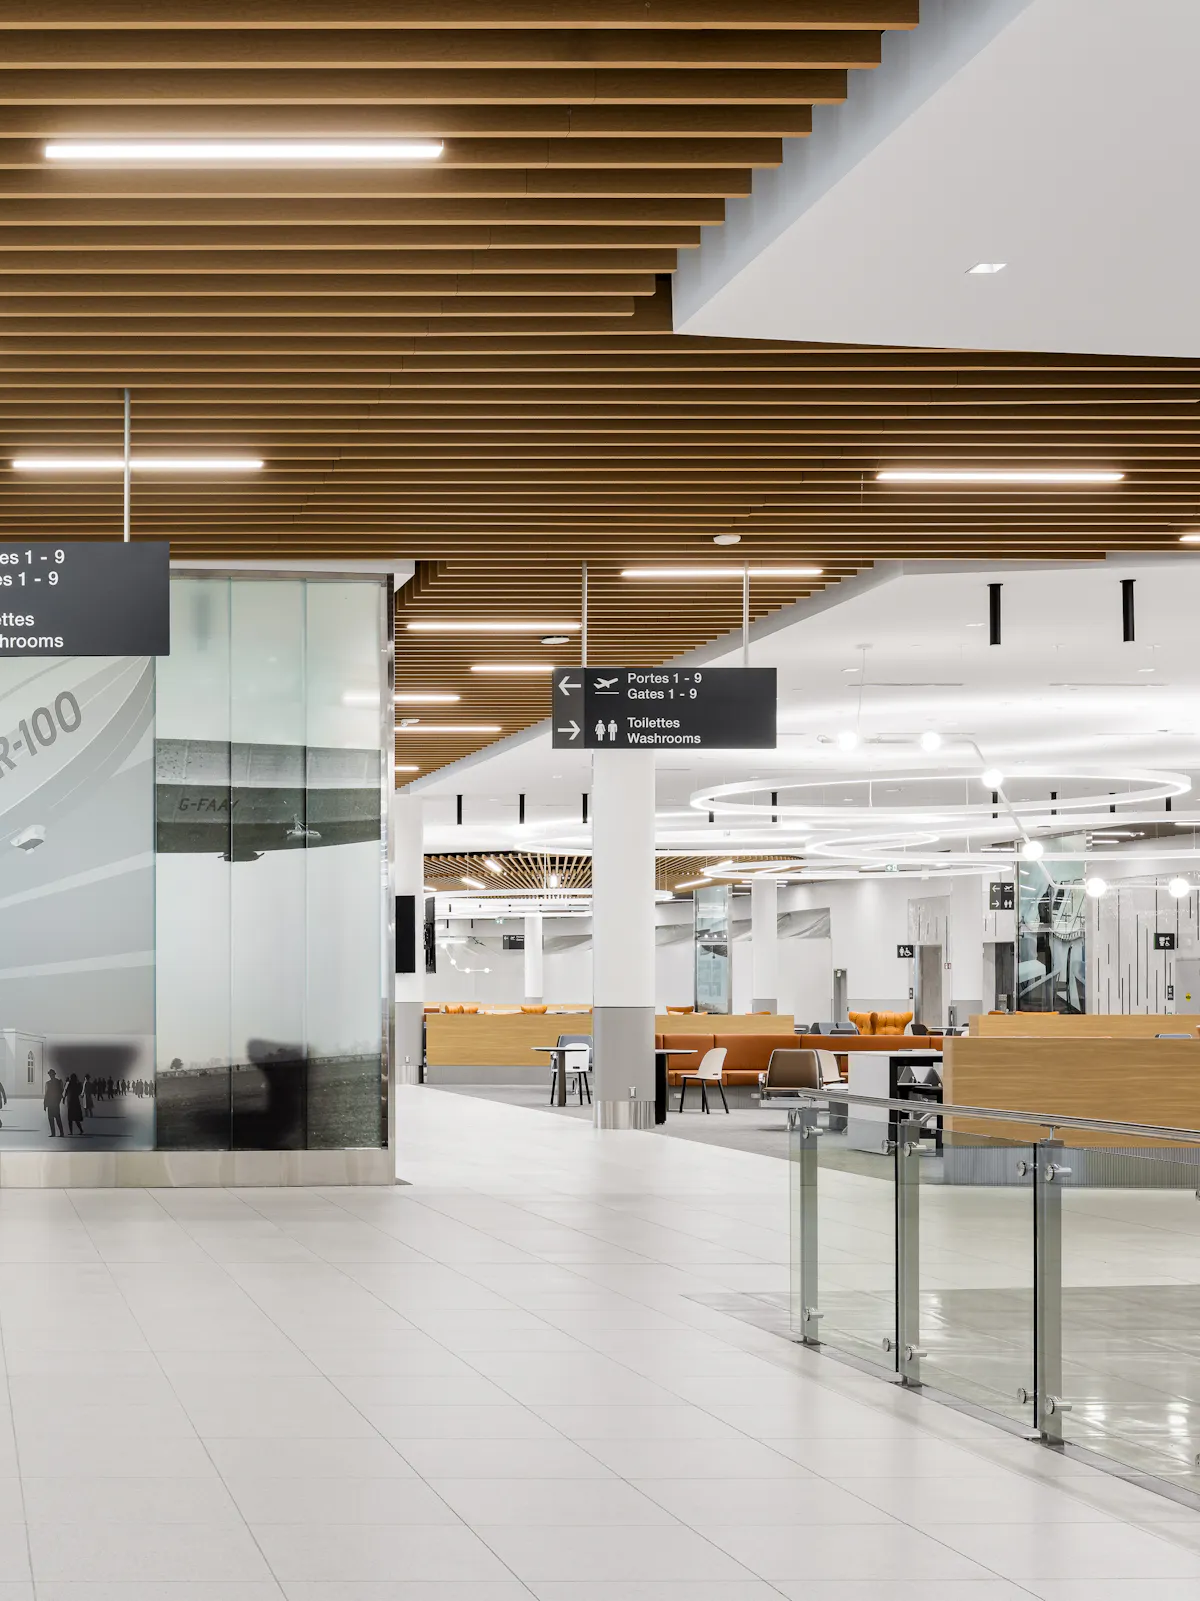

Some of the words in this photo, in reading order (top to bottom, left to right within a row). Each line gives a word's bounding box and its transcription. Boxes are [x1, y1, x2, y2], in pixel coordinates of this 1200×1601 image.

[24, 549, 33, 565] 1
[54, 548, 66, 565] 9
[17, 571, 26, 587] 1
[47, 570, 59, 586] 9
[627, 672, 669, 684] Portes
[672, 672, 679, 683] 1
[693, 672, 703, 684] 9
[627, 688, 665, 700] Gates
[668, 688, 674, 699] 1
[689, 688, 698, 700] 9
[626, 716, 681, 728] Toilettes
[626, 732, 702, 744] Washrooms
